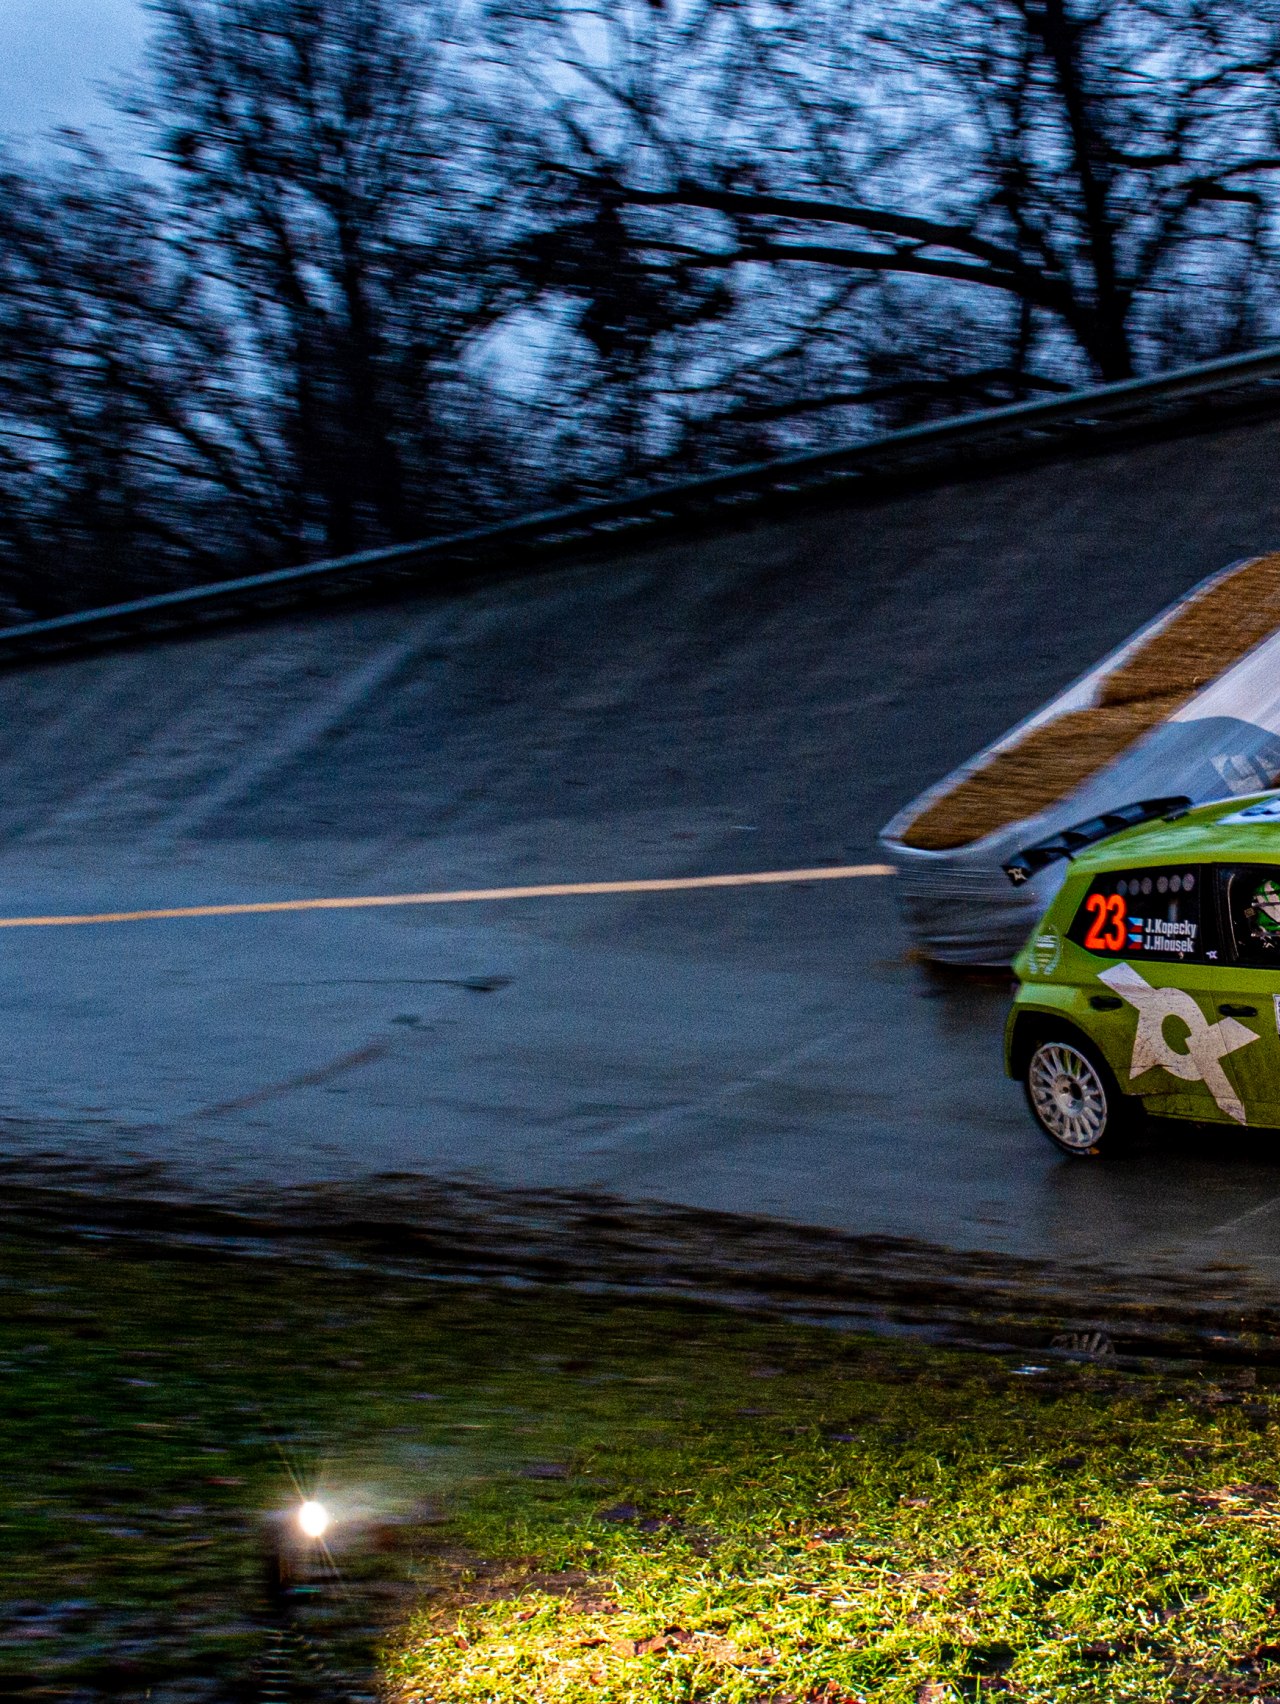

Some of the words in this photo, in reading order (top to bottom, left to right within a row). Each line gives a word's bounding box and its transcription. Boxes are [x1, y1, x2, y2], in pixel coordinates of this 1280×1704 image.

[1085, 893, 1127, 951] 23
[1145, 918, 1196, 937] J.Kopecky
[1144, 935, 1194, 952] J.Hlousek
